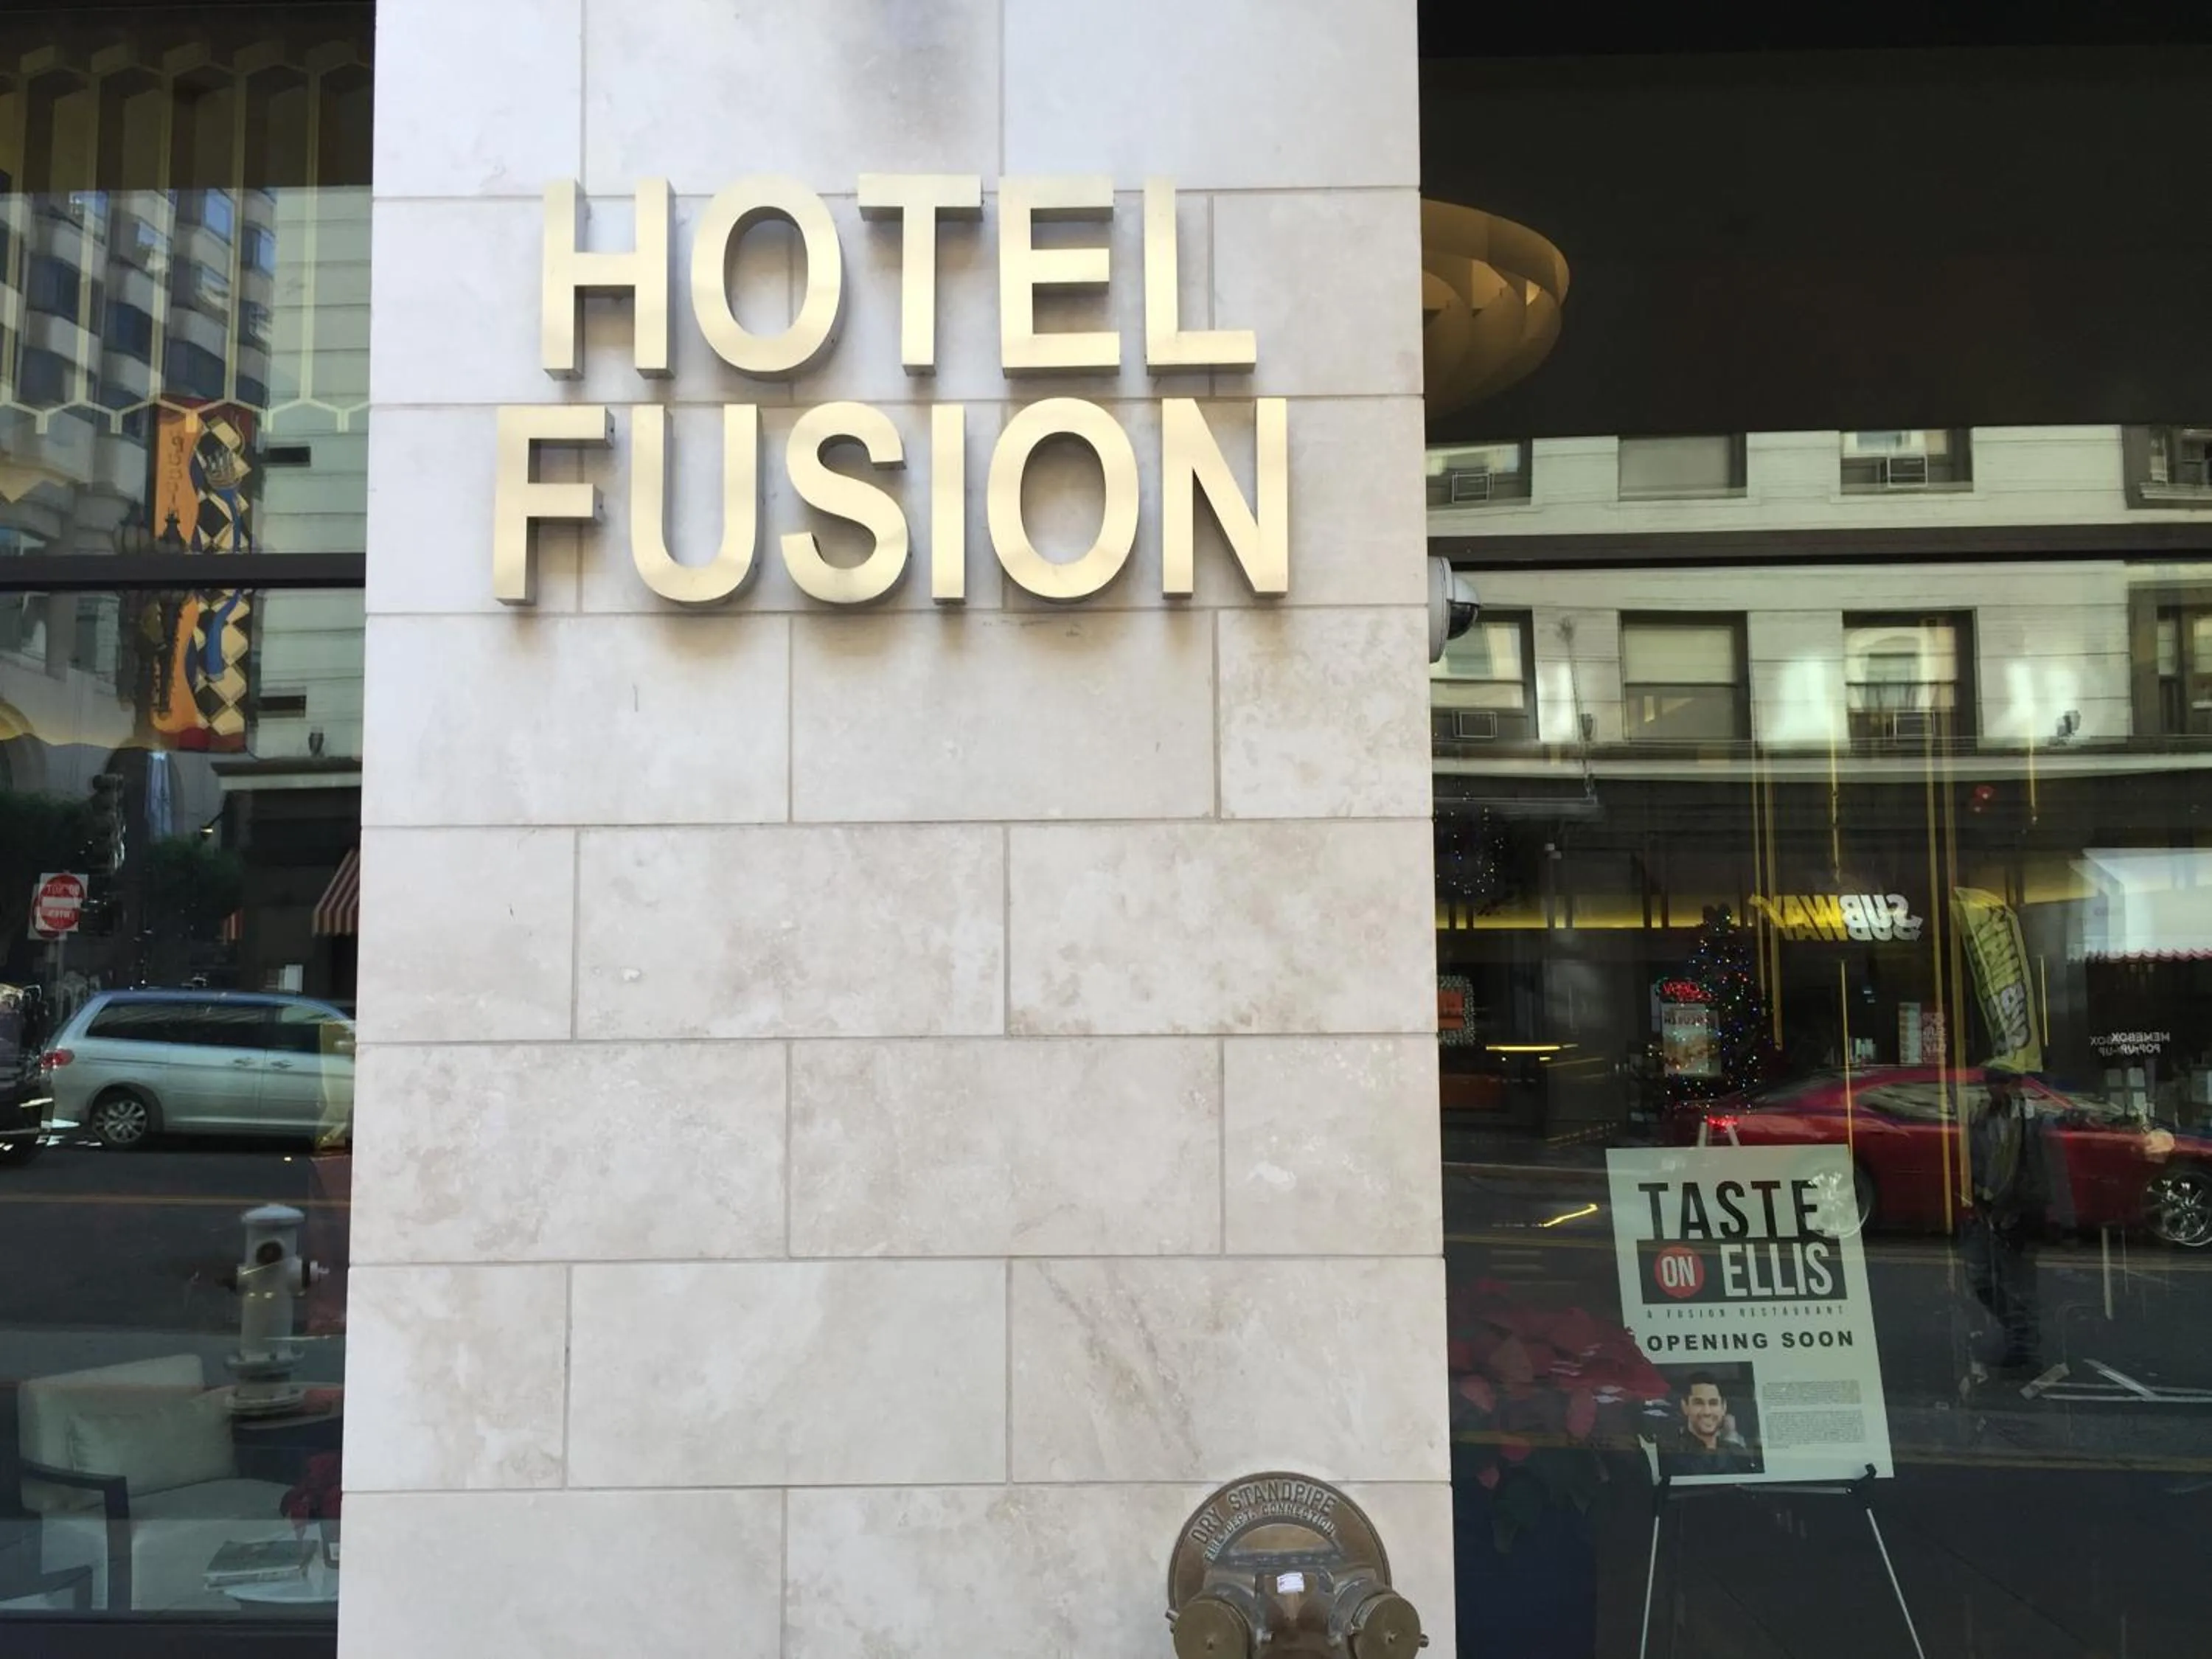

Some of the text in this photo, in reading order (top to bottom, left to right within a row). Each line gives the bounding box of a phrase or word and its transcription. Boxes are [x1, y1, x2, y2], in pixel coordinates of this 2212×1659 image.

[542, 174, 1256, 379] HOTEL
[492, 397, 1288, 604] FUSION
[1638, 1180, 1825, 1240] TASTE
[1660, 1242, 1833, 1297] ON ELLIS
[1646, 1330, 1854, 1352] OPENING SOON
[1666, 1308, 1726, 1318] FUSION
[1739, 1305, 1843, 1318] RESTAURANT
[1190, 1479, 1338, 1545] DRY STANDPIPE
